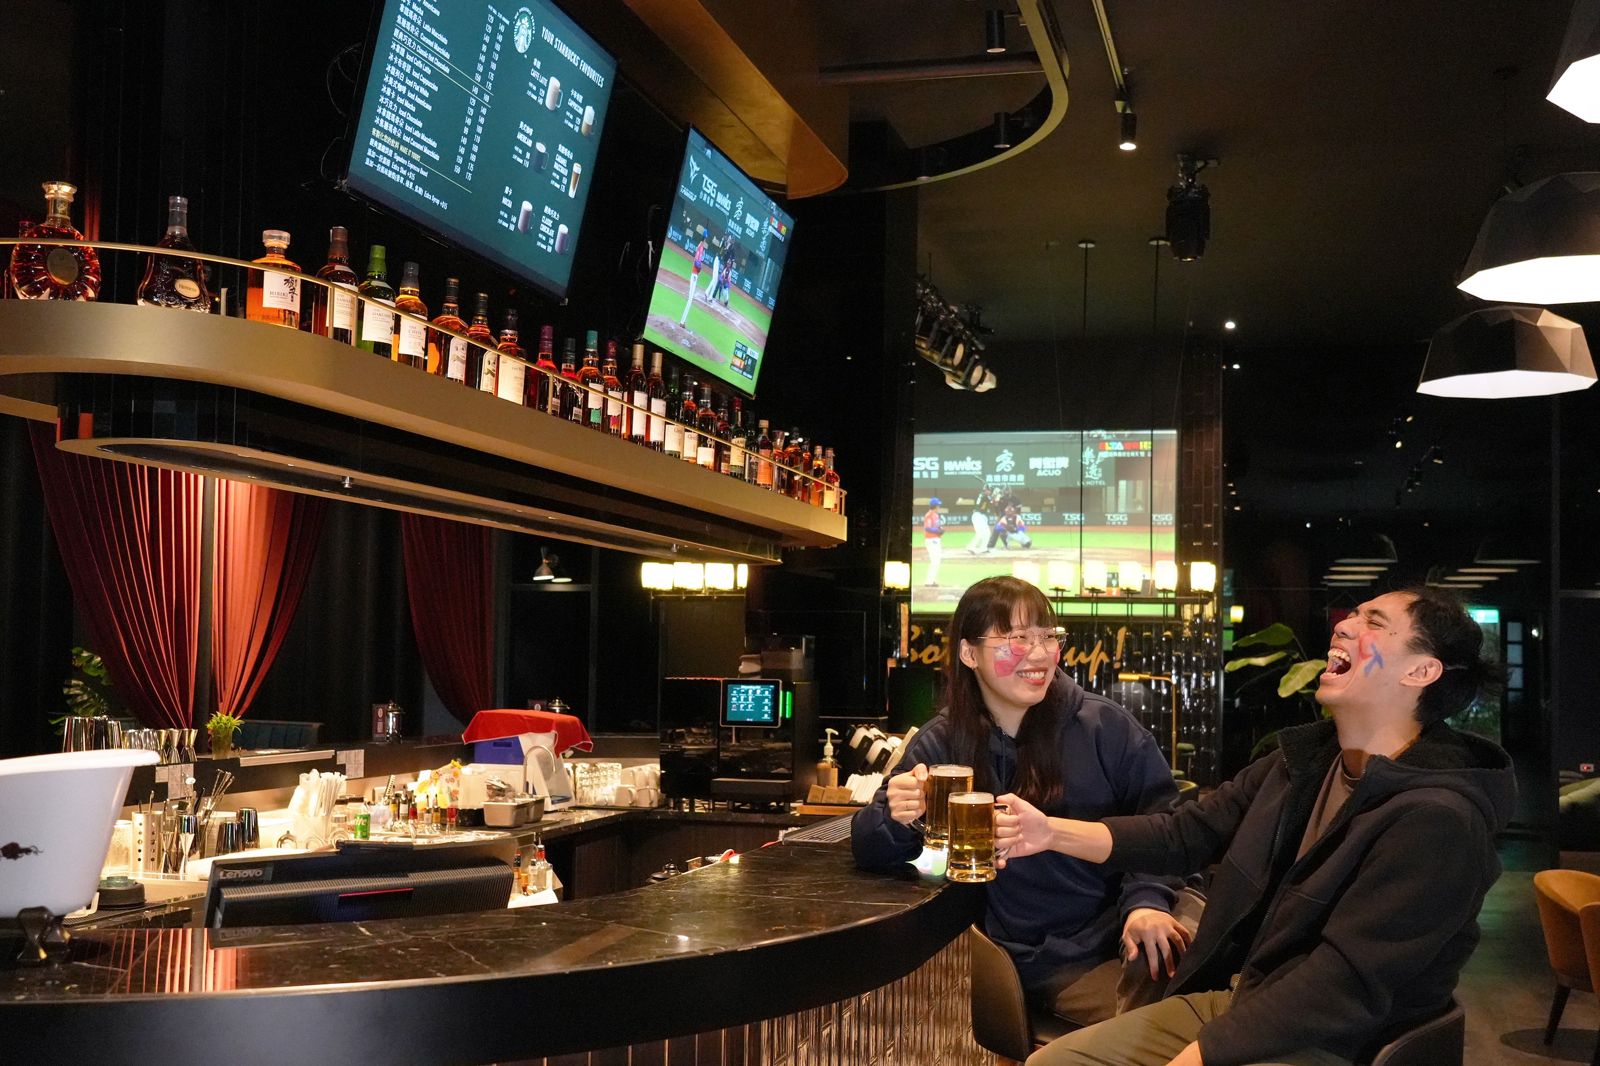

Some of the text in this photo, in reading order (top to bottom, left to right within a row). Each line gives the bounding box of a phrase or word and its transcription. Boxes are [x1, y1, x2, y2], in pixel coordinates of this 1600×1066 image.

[542, 26, 554, 45] YOUR
[580, 60, 604, 87] FAVOURITES
[703, 174, 718, 198] TSG
[913, 457, 939, 471] SG
[1105, 513, 1128, 521] TSG
[1063, 626, 1127, 682] up!
[220, 869, 263, 879] Lenovo
